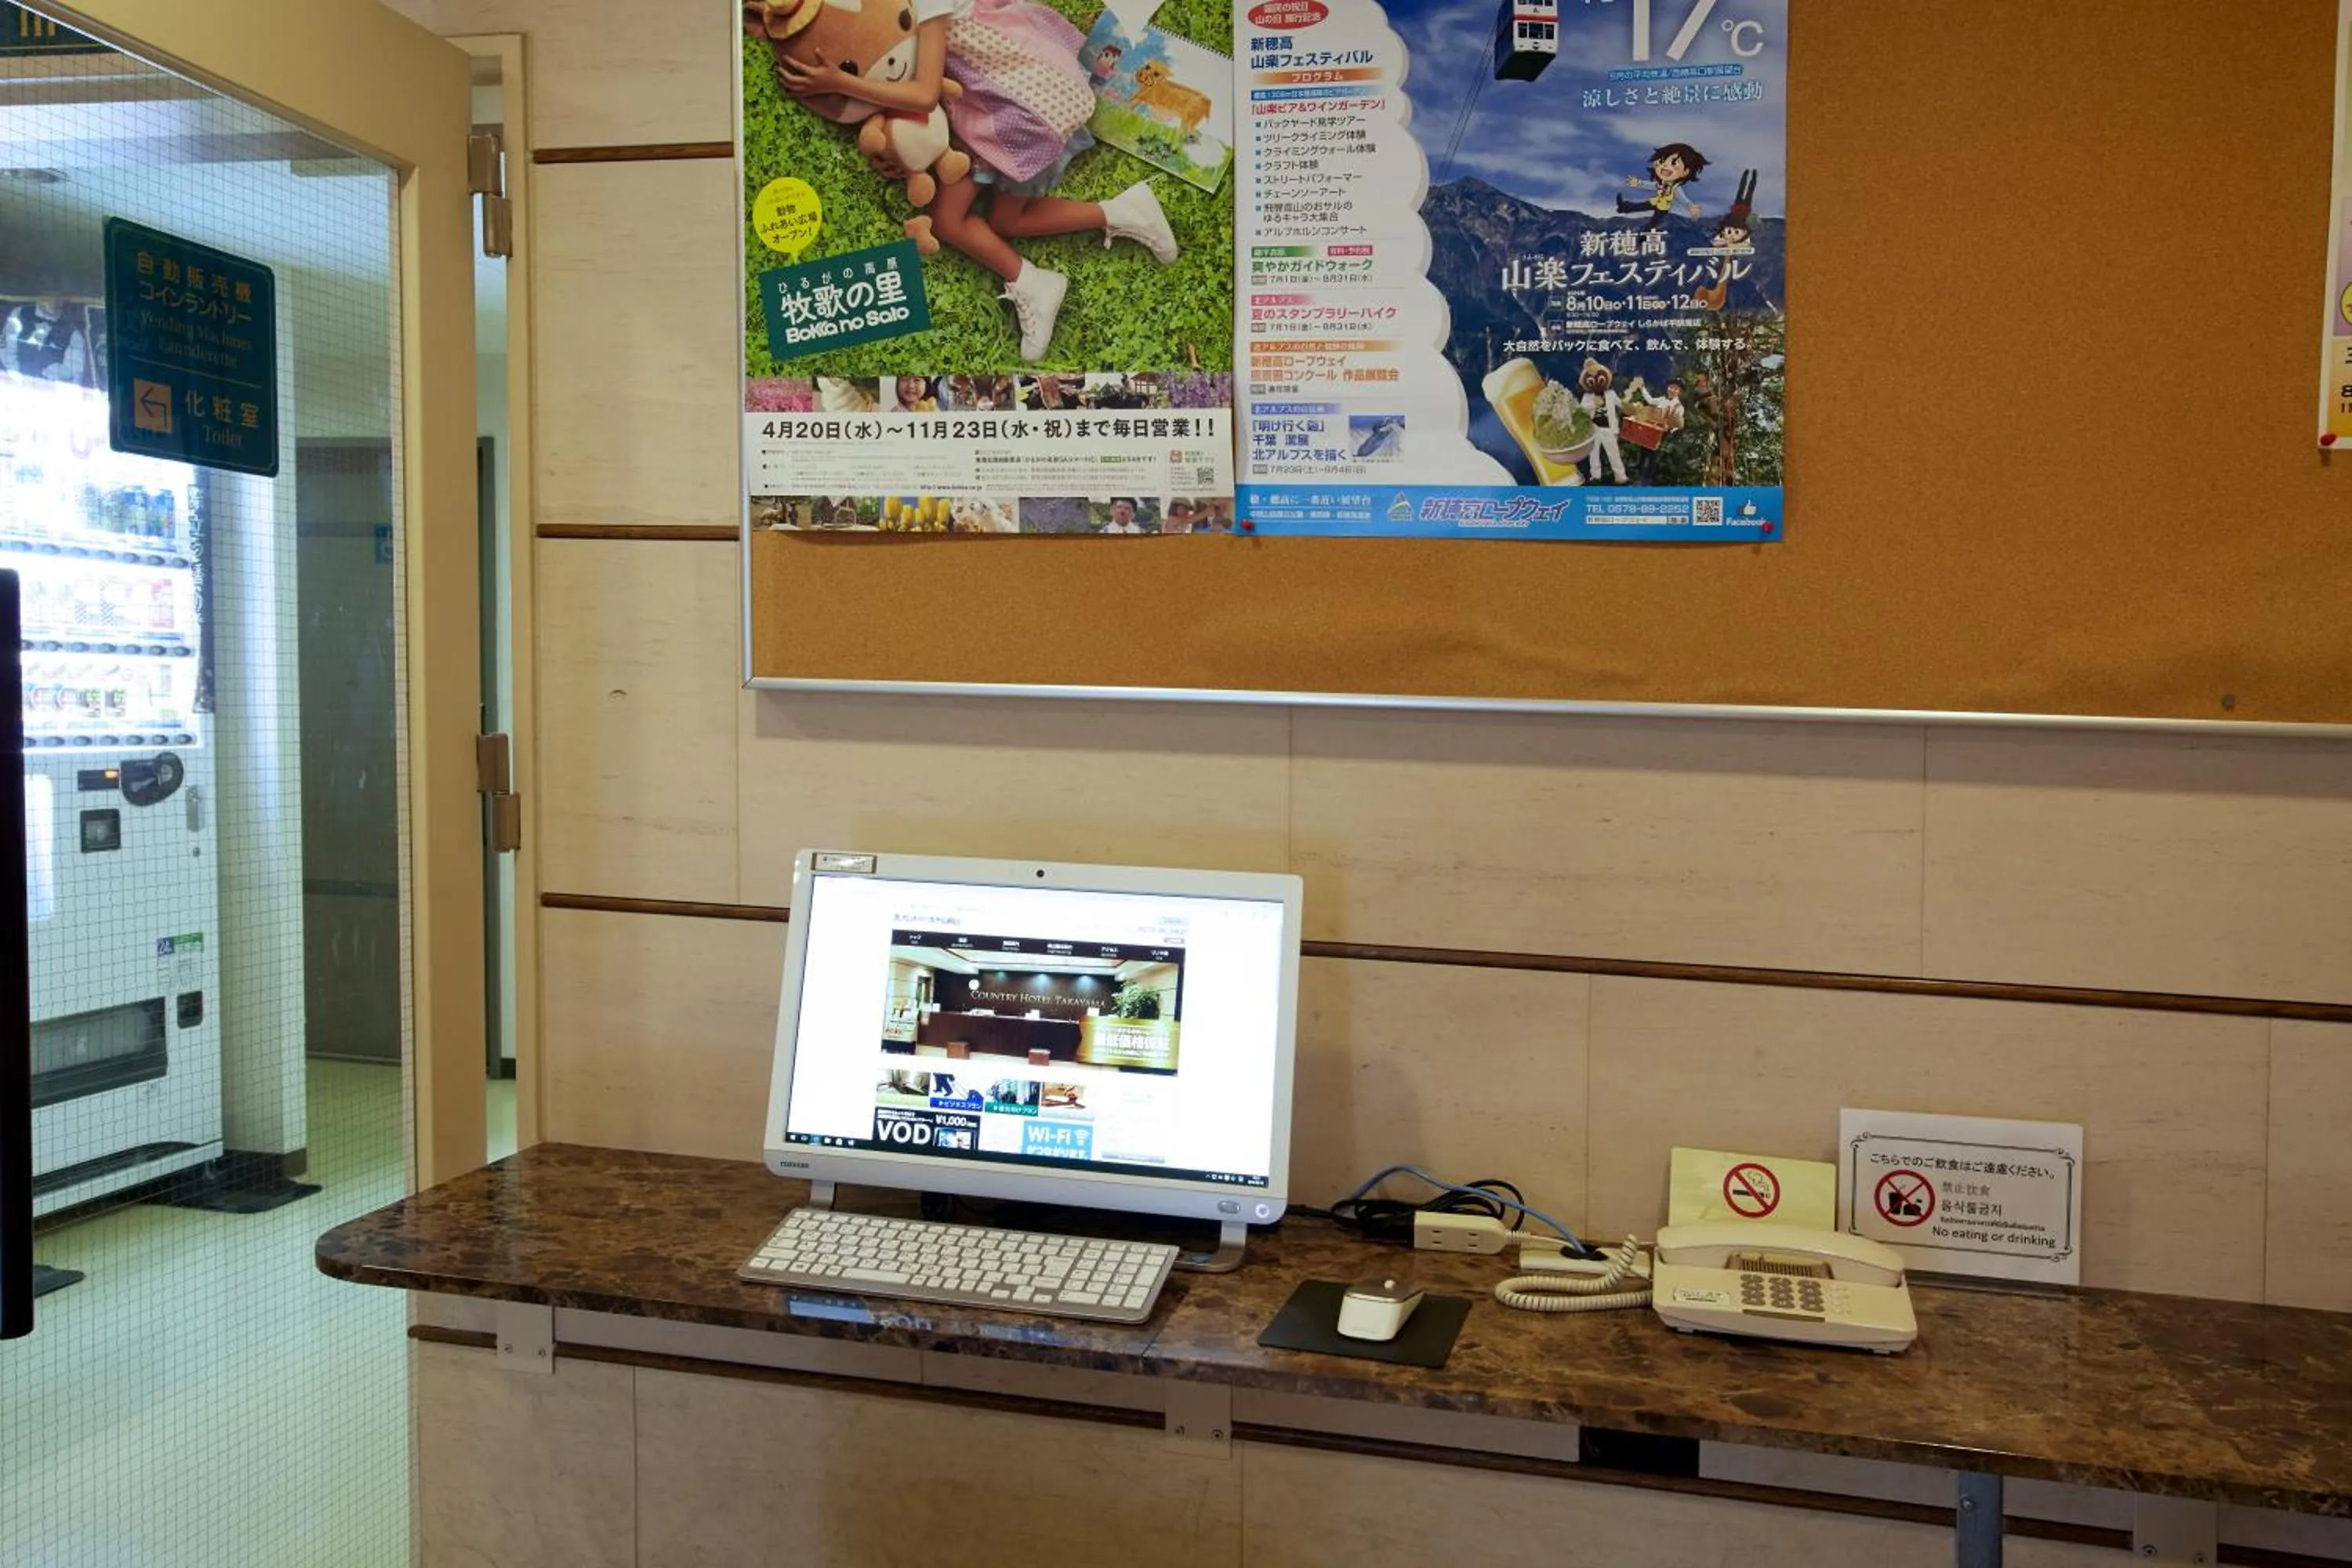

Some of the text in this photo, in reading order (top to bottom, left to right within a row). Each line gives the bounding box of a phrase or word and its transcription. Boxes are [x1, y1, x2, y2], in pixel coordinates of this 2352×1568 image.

[1250, 36, 1294, 51] 新穂高
[1250, 50, 1374, 69] 山楽フェスティバル
[1292, 71, 1343, 82] プログラム
[1582, 81, 1762, 108] 涼しさと絶景に感動
[1264, 116, 1367, 129] バックヤード見学ツアー
[1264, 129, 1367, 143] ツリークライミング体験
[1264, 143, 1377, 157] クライミングウォール体験
[1264, 159, 1319, 171] クラフト体験
[1264, 173, 1363, 185] ストリートパフォーマー
[1264, 187, 1346, 198] チェーンソーアート
[761, 212, 818, 233] ふれあい広場
[1580, 227, 1668, 257] 新穂高
[778, 256, 899, 294] ひるがの高原
[1252, 259, 1374, 273] 爽やかガイドウォーク
[1501, 256, 1753, 292] 山楽フェスティバル
[136, 250, 252, 304] 自動販売機
[139, 280, 252, 325] コインランドリー
[780, 270, 908, 325] 牧歌の里
[1252, 307, 1397, 320] 夏のスタンプラリーハイク
[840, 316, 865, 333] no
[185, 390, 260, 430] 化粧室
[201, 424, 243, 448] Toilet
[1252, 434, 1277, 446] 千葉
[1252, 448, 1347, 461] 北アルプスを描く
[1420, 495, 1570, 521] 新穂高ロープウェイ
[1586, 504, 1604, 514] TEL
[971, 989, 1018, 1003] COUNTRY
[877, 1120, 931, 1144] VOD
[1028, 1125, 1070, 1144] Wi-Fi
[1870, 1152, 2056, 1179] こちらでのご飲食はご遠慮ください。
[1932, 1225, 2056, 1248] No eating or drinking
